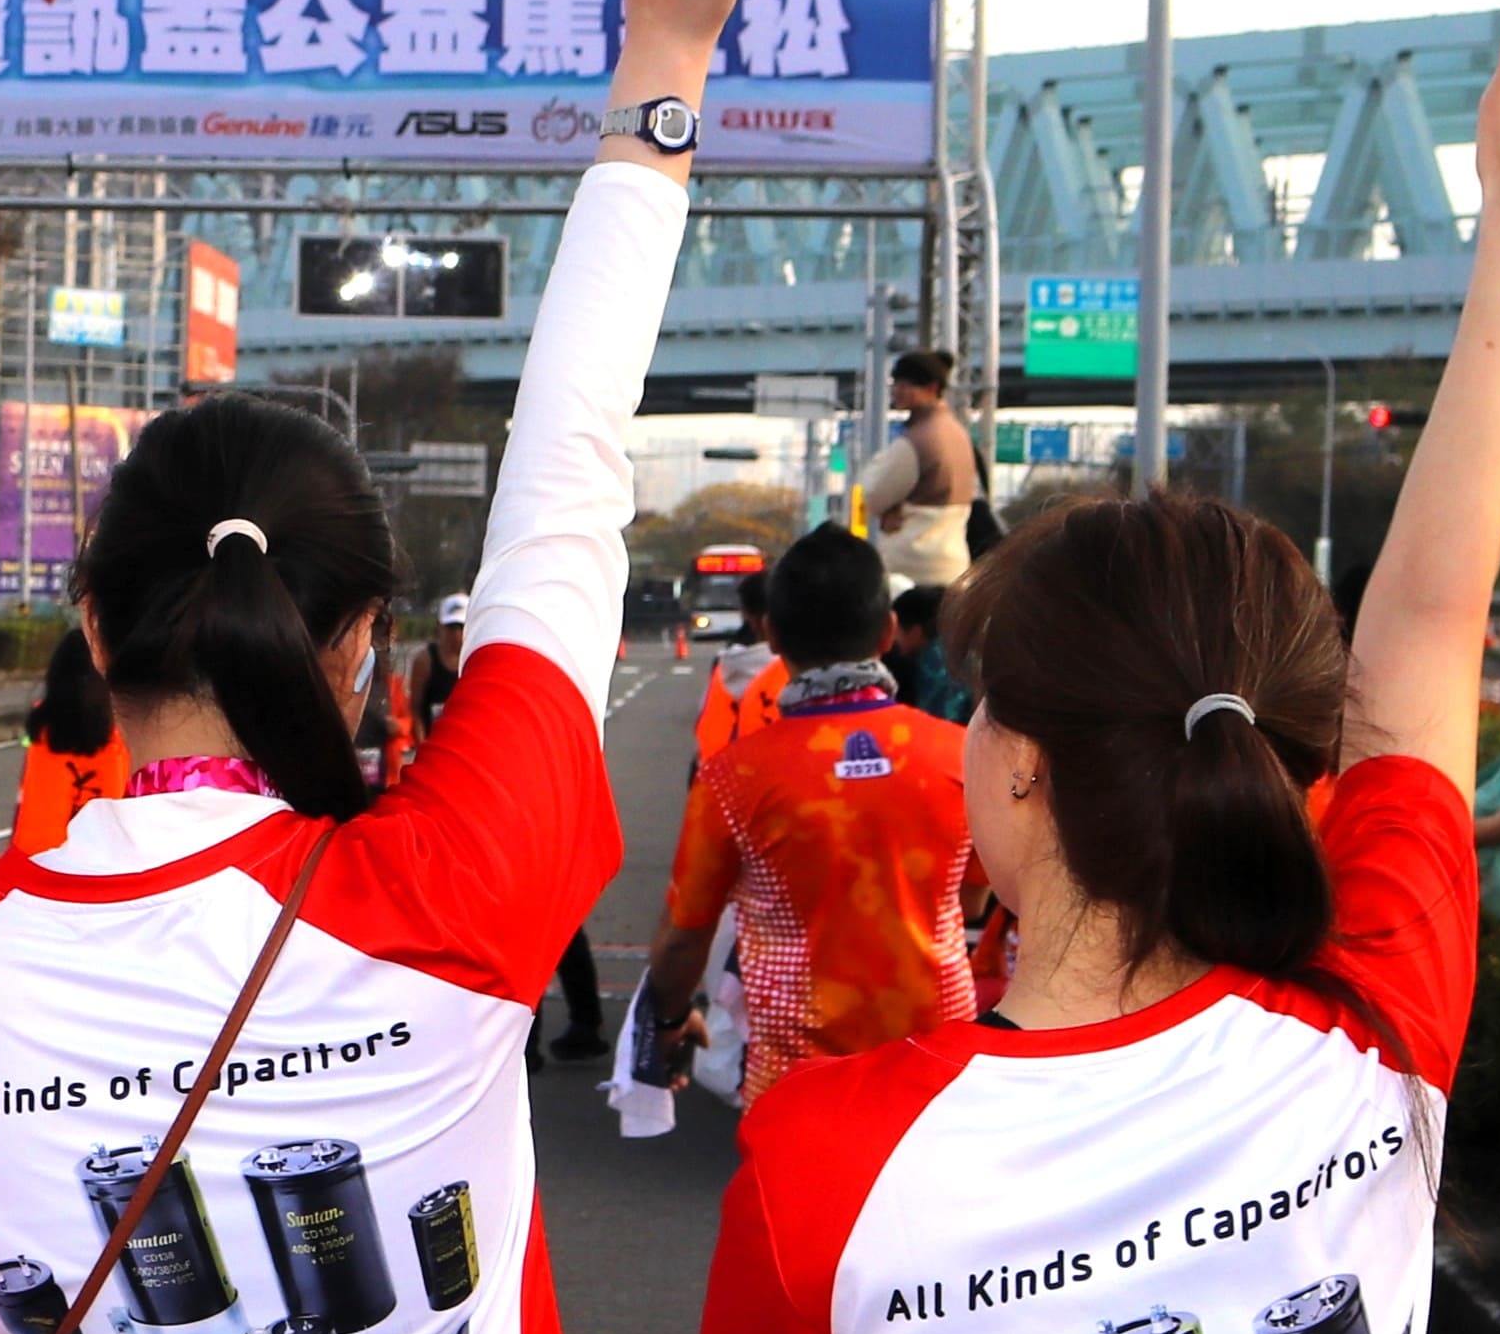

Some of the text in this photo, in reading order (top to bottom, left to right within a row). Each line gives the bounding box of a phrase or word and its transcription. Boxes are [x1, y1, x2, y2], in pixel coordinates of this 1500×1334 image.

[203, 110, 305, 138] Genuine
[395, 112, 508, 137] ASUS
[721, 108, 837, 130] aiwa
[108, 1066, 153, 1102] of
[285, 1206, 344, 1229] Suntan
[885, 1124, 1404, 1322] All Kinds of Capacitors
